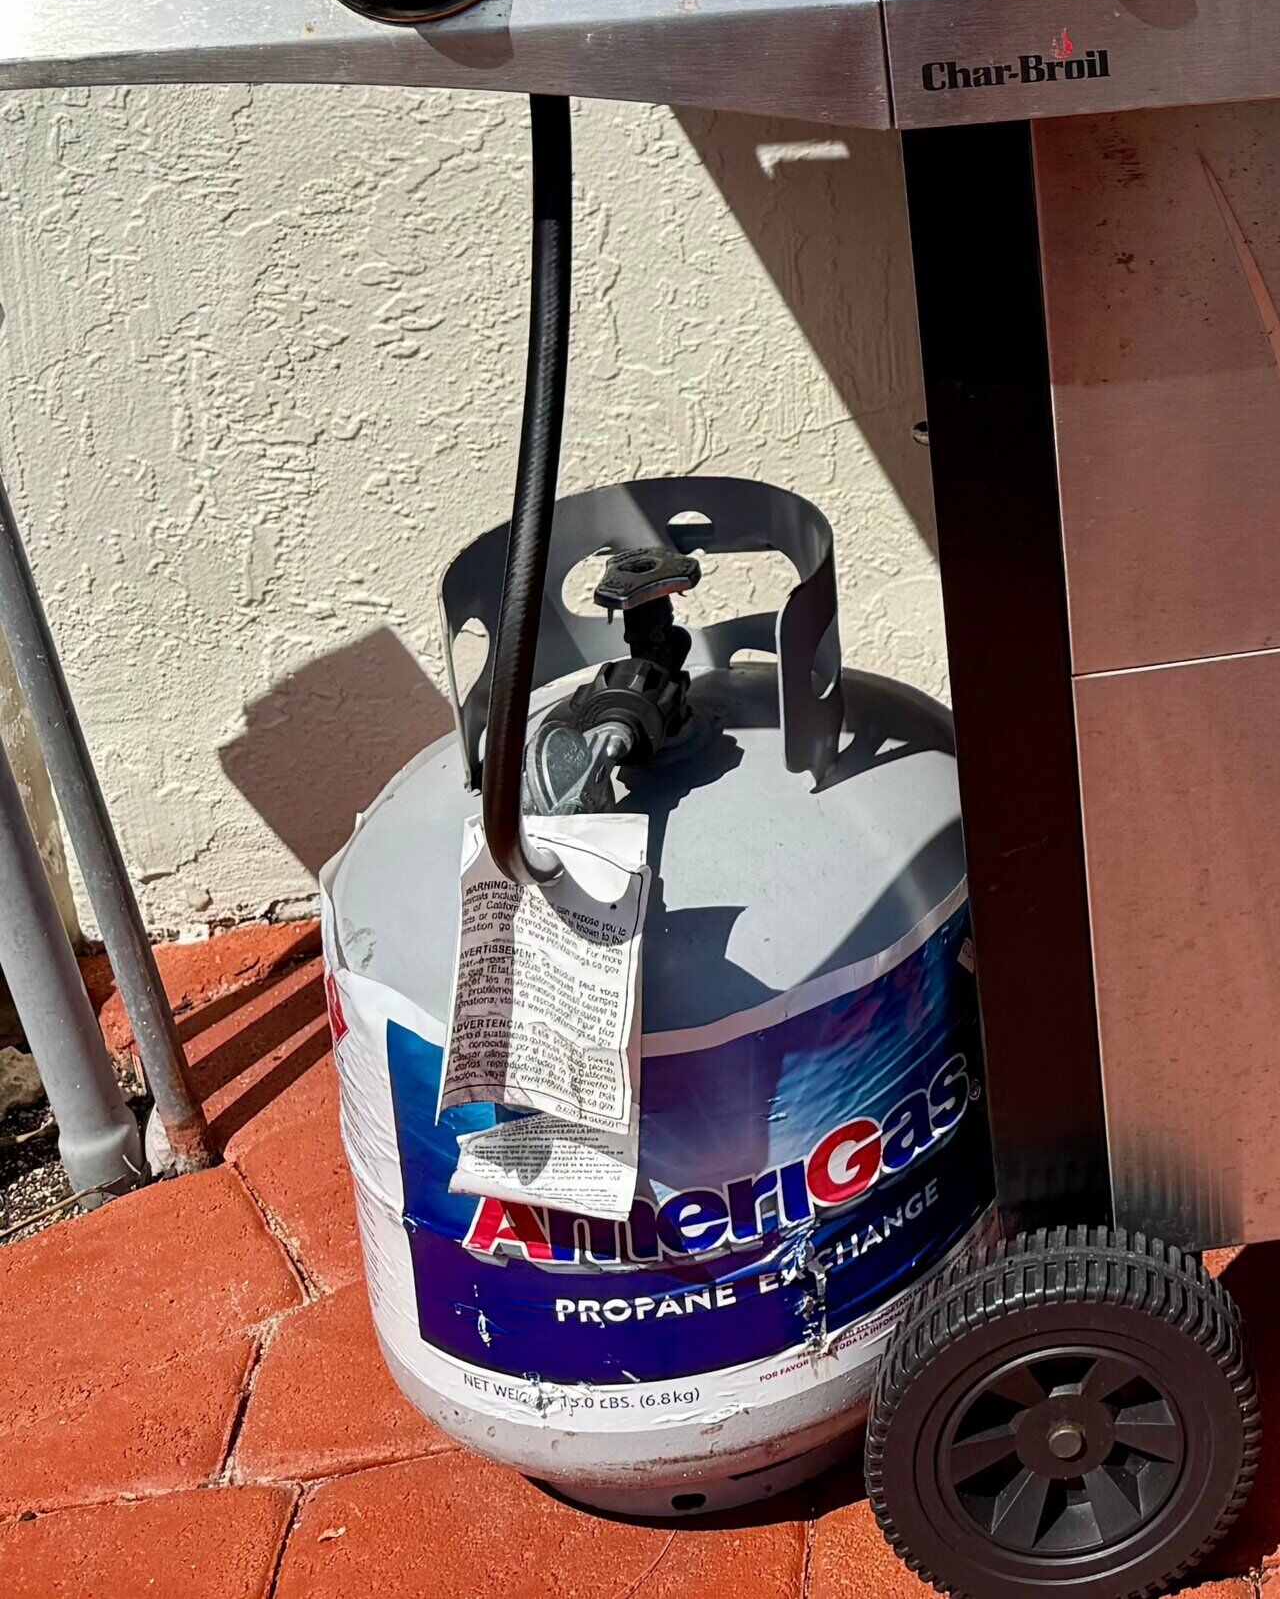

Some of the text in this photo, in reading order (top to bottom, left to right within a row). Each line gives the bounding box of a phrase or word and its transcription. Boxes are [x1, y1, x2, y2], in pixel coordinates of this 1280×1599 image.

[921, 49, 1111, 91] Char-Broil
[461, 1052, 971, 1267] AmeriGas
[555, 1280, 737, 1325] PROPANE
[463, 1372, 490, 1393] NET
[759, 1370, 779, 1382] POR
[780, 1358, 810, 1377] FAVOR
